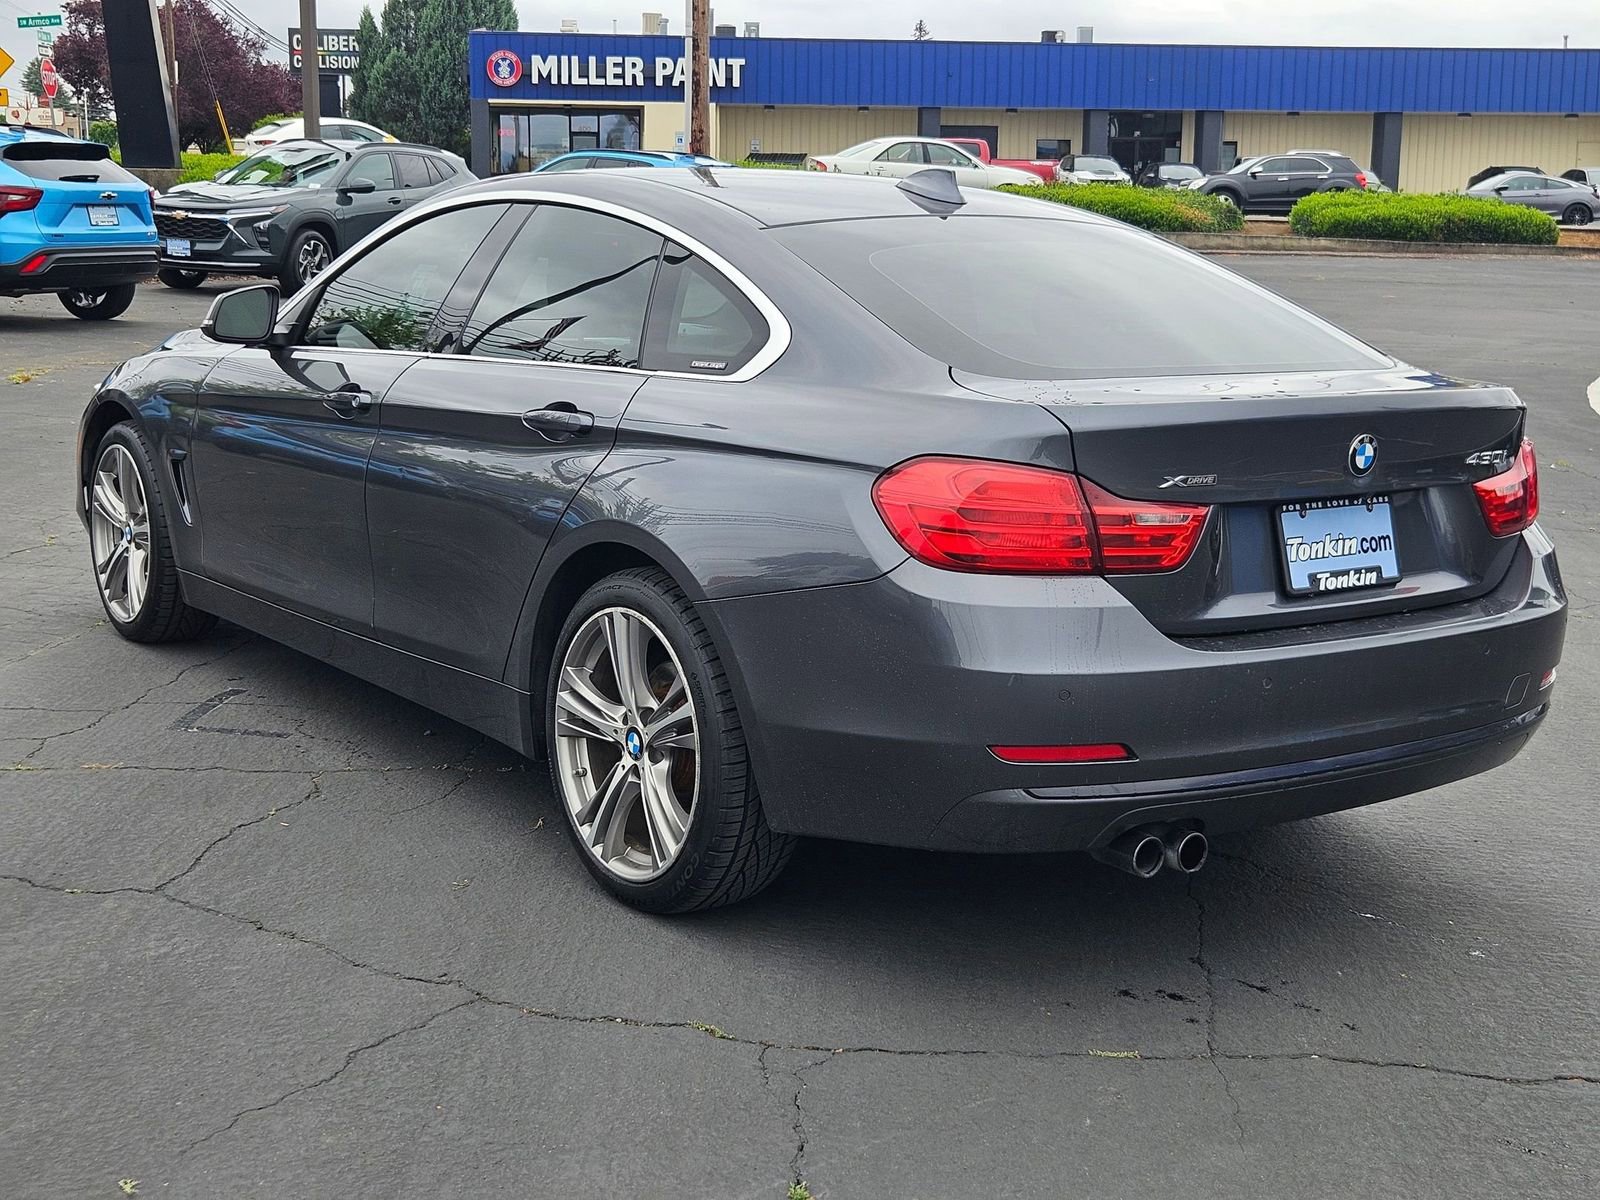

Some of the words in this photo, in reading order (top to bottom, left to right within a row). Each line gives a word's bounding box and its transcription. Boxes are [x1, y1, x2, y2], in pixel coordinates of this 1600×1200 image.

[28, 18, 50, 26] Armco
[293, 34, 359, 51] CLIBER
[294, 55, 359, 69] CLISION
[43, 71, 56, 85] STOP
[531, 55, 644, 86] MILLER
[655, 57, 746, 88] PANT
[1282, 504, 1300, 512] FOR
[1305, 501, 1322, 509] THE
[1327, 499, 1350, 507] LOVE
[1366, 496, 1389, 504] CARS
[1286, 533, 1393, 562] Tonkin.com
[1316, 569, 1377, 590] Tonkin
